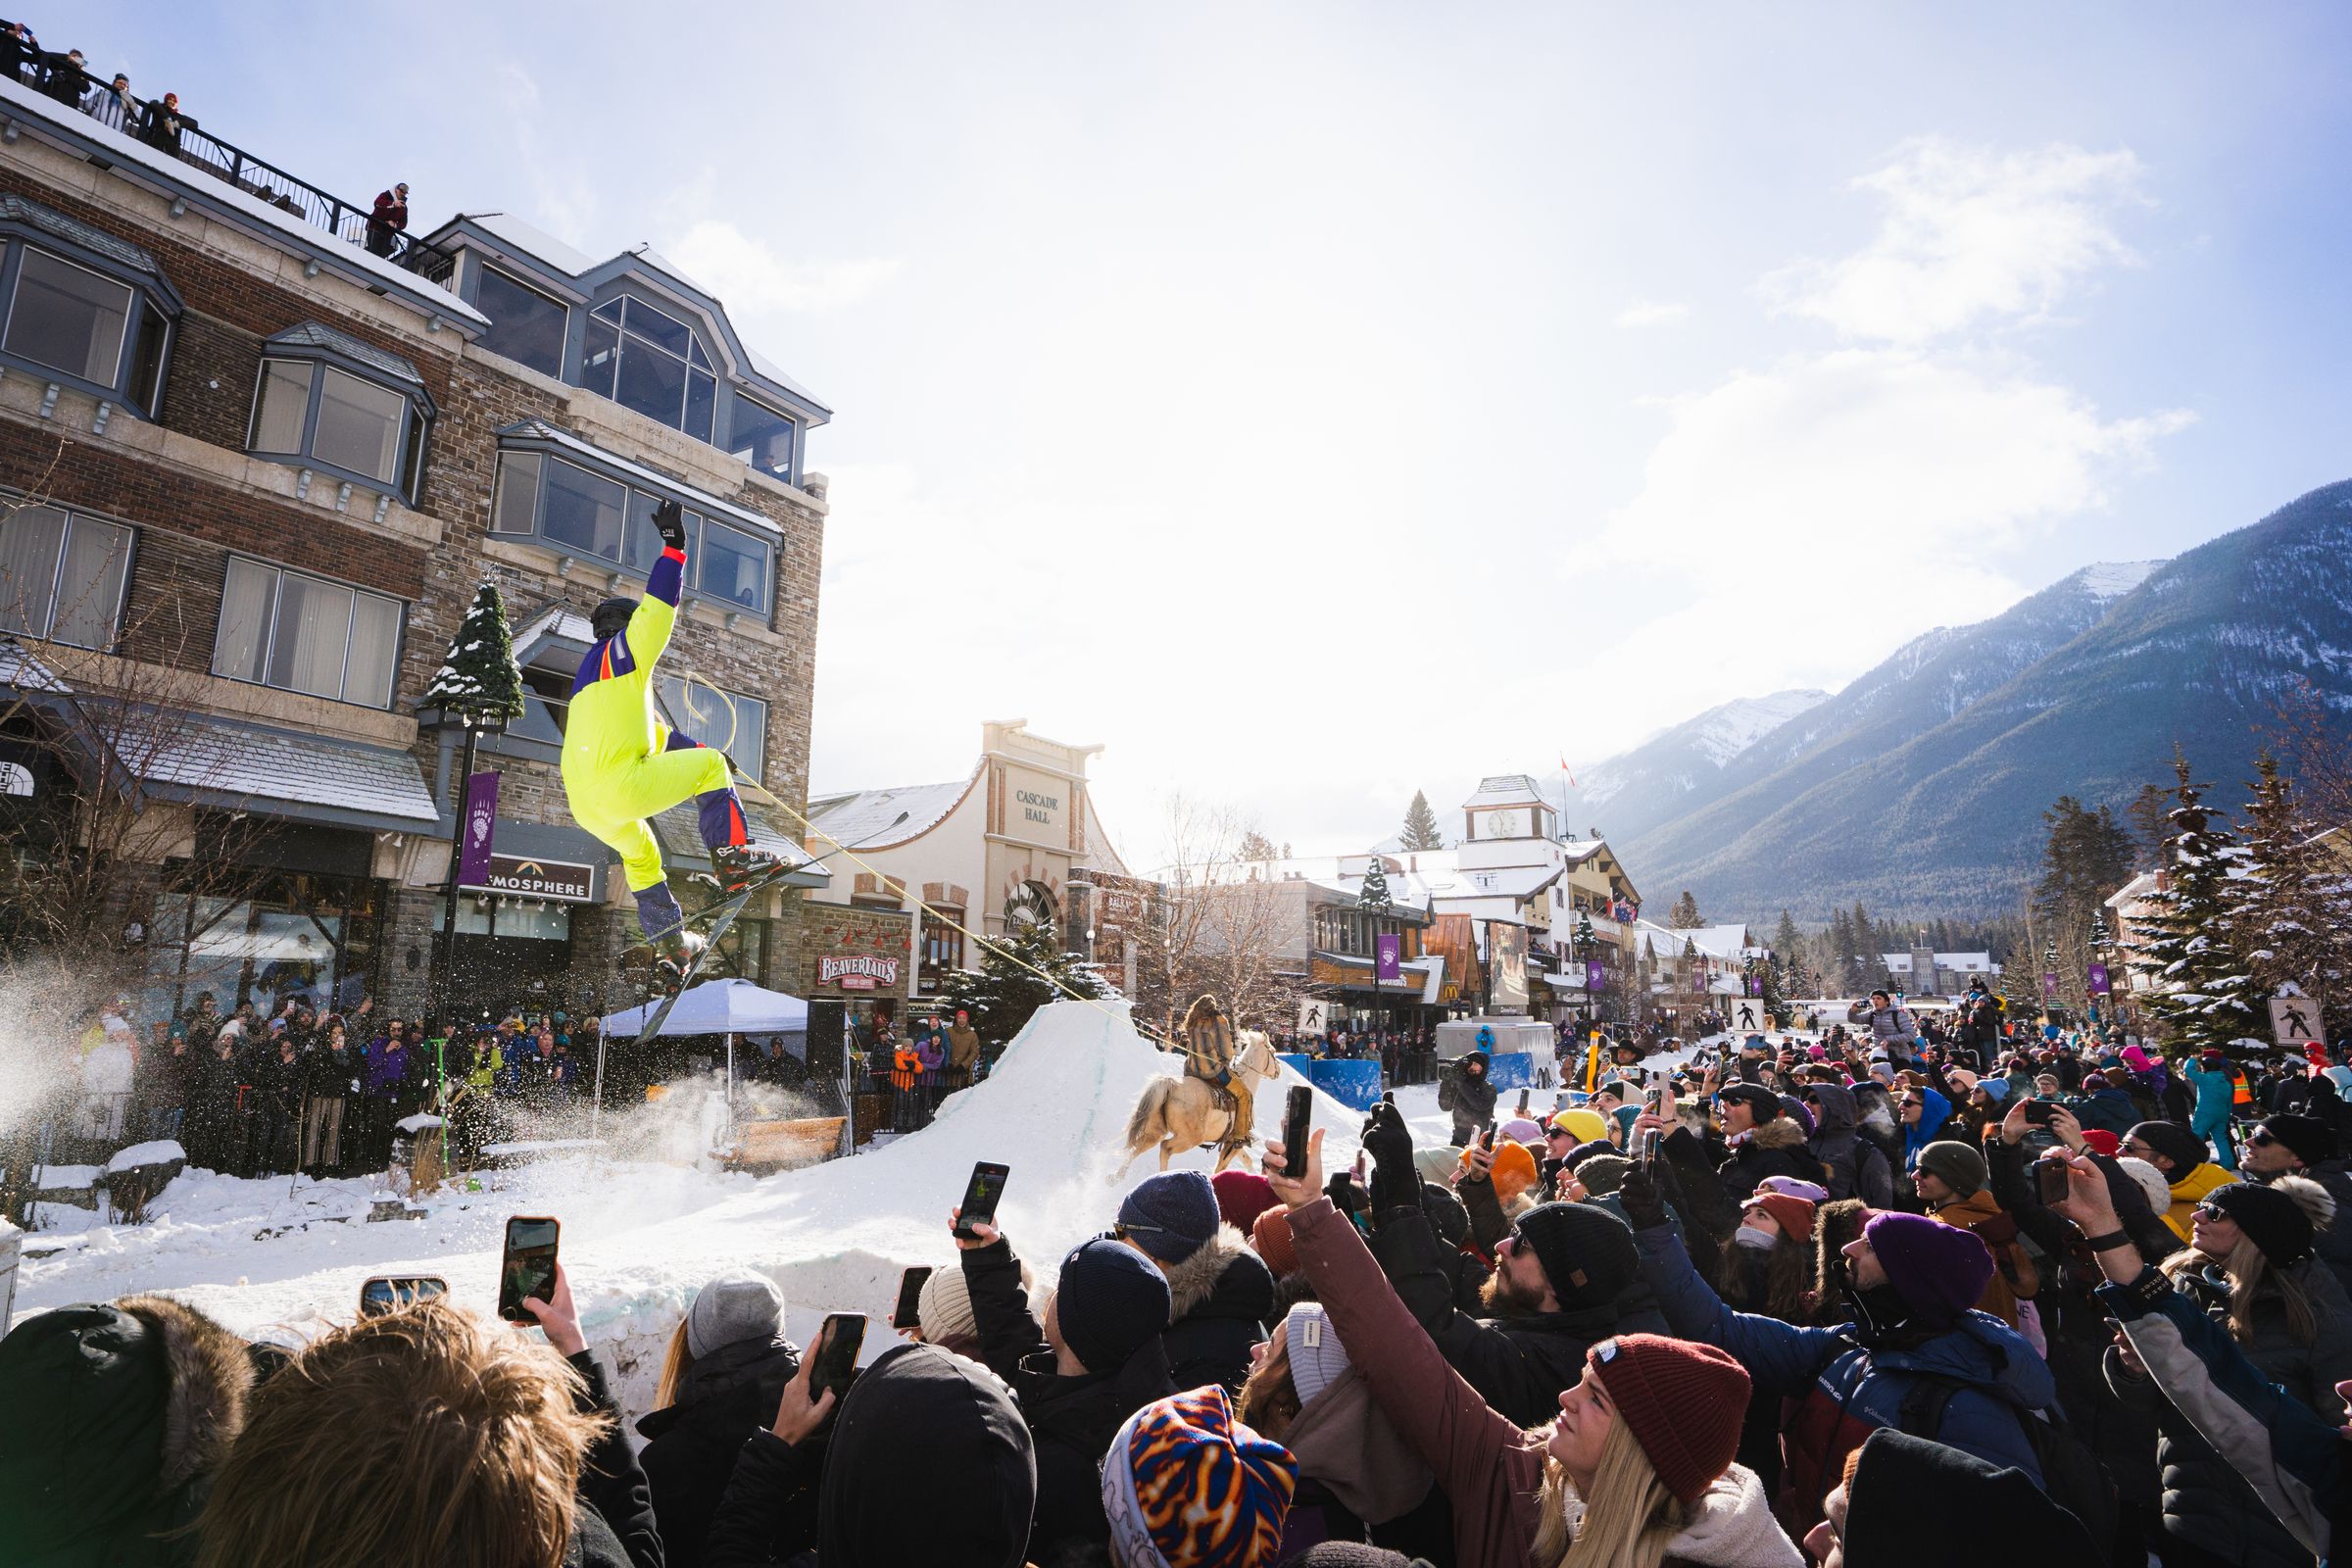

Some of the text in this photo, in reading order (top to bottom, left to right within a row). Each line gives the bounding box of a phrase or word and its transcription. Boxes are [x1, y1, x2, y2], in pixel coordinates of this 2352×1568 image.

[1016, 790, 1057, 810] CASCADE
[1025, 808, 1050, 823] HALL
[485, 875, 585, 896] MOSPHERE
